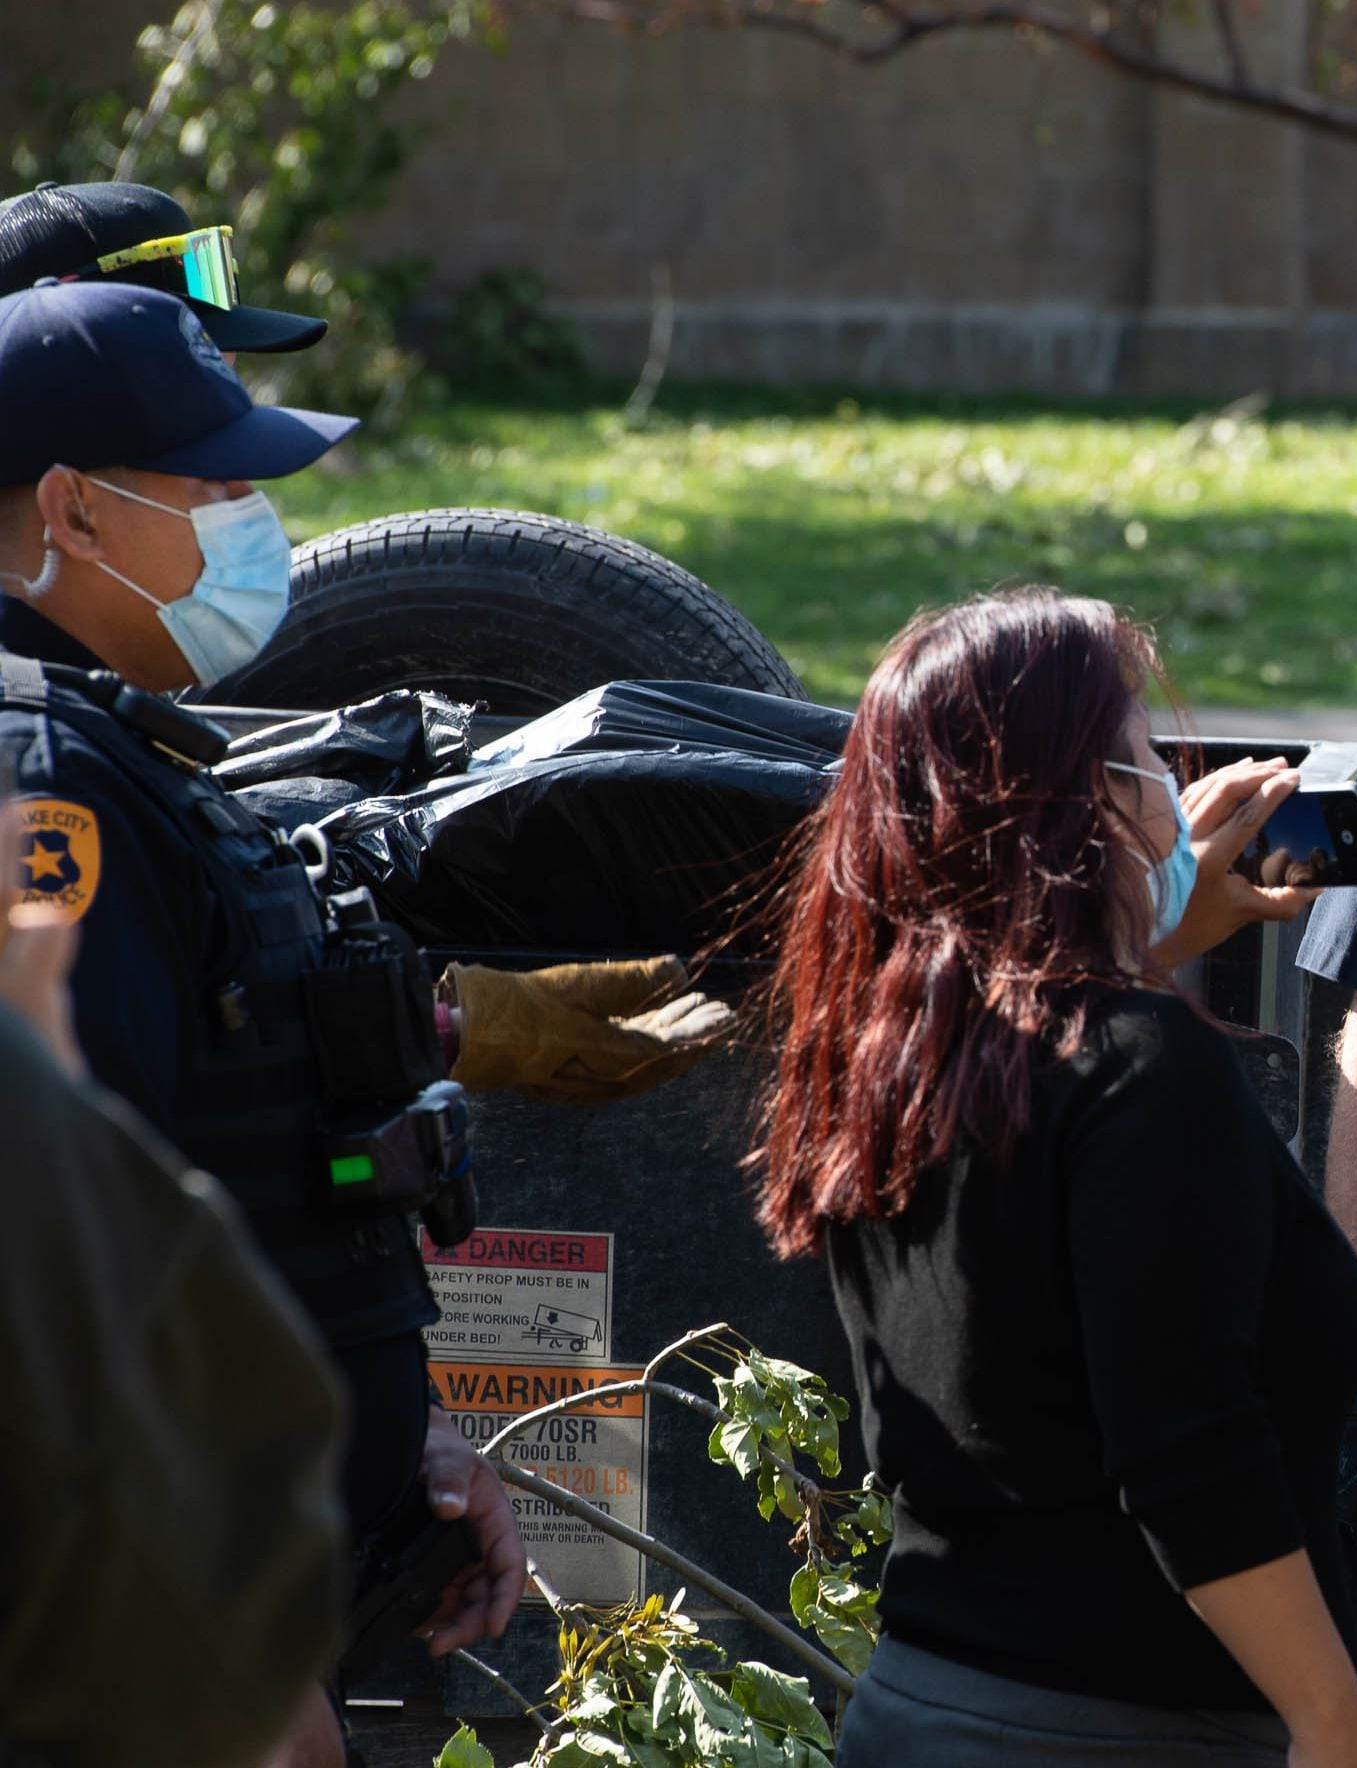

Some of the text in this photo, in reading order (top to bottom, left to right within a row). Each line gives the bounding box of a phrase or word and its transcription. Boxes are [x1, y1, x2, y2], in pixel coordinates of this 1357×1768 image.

[52, 810, 90, 832] CITY
[469, 1237, 585, 1265] DANGER
[476, 1274, 513, 1286] PROP
[516, 1276, 552, 1287] MUST
[556, 1278, 573, 1288] BE
[577, 1278, 590, 1289] IN
[443, 1292, 503, 1305] POSITION
[473, 1312, 530, 1326] WORKING
[536, 1419, 597, 1444] 70SR
[510, 1443, 550, 1461] 7000
[556, 1446, 582, 1463] LB.
[602, 1466, 634, 1496] LB.
[518, 1521, 540, 1532] THIS
[542, 1523, 588, 1533] WARNING
[520, 1533, 605, 1545] INJURY OR DEATH
